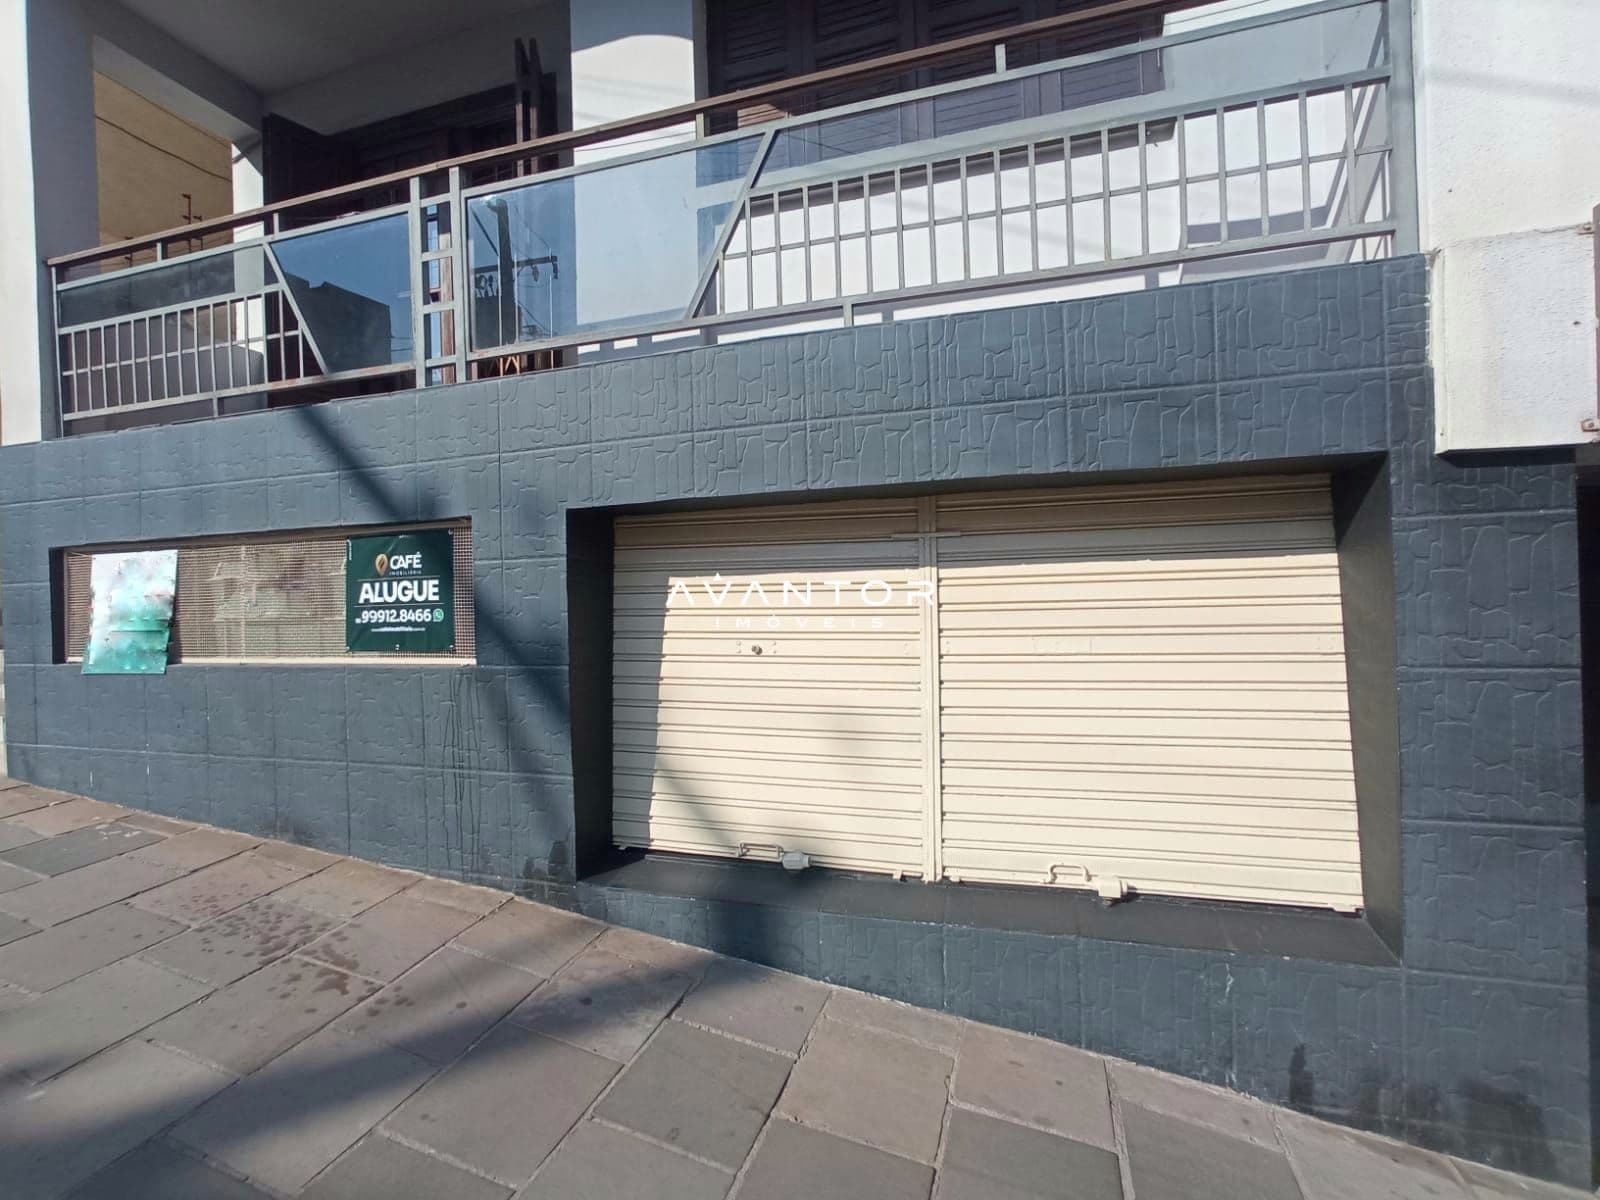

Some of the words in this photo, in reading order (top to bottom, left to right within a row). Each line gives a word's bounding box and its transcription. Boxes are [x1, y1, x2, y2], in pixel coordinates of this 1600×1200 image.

[390, 552, 422, 569] CAFÉ
[358, 580, 440, 603] ALUGUE
[361, 608, 432, 623] 99912.8466
